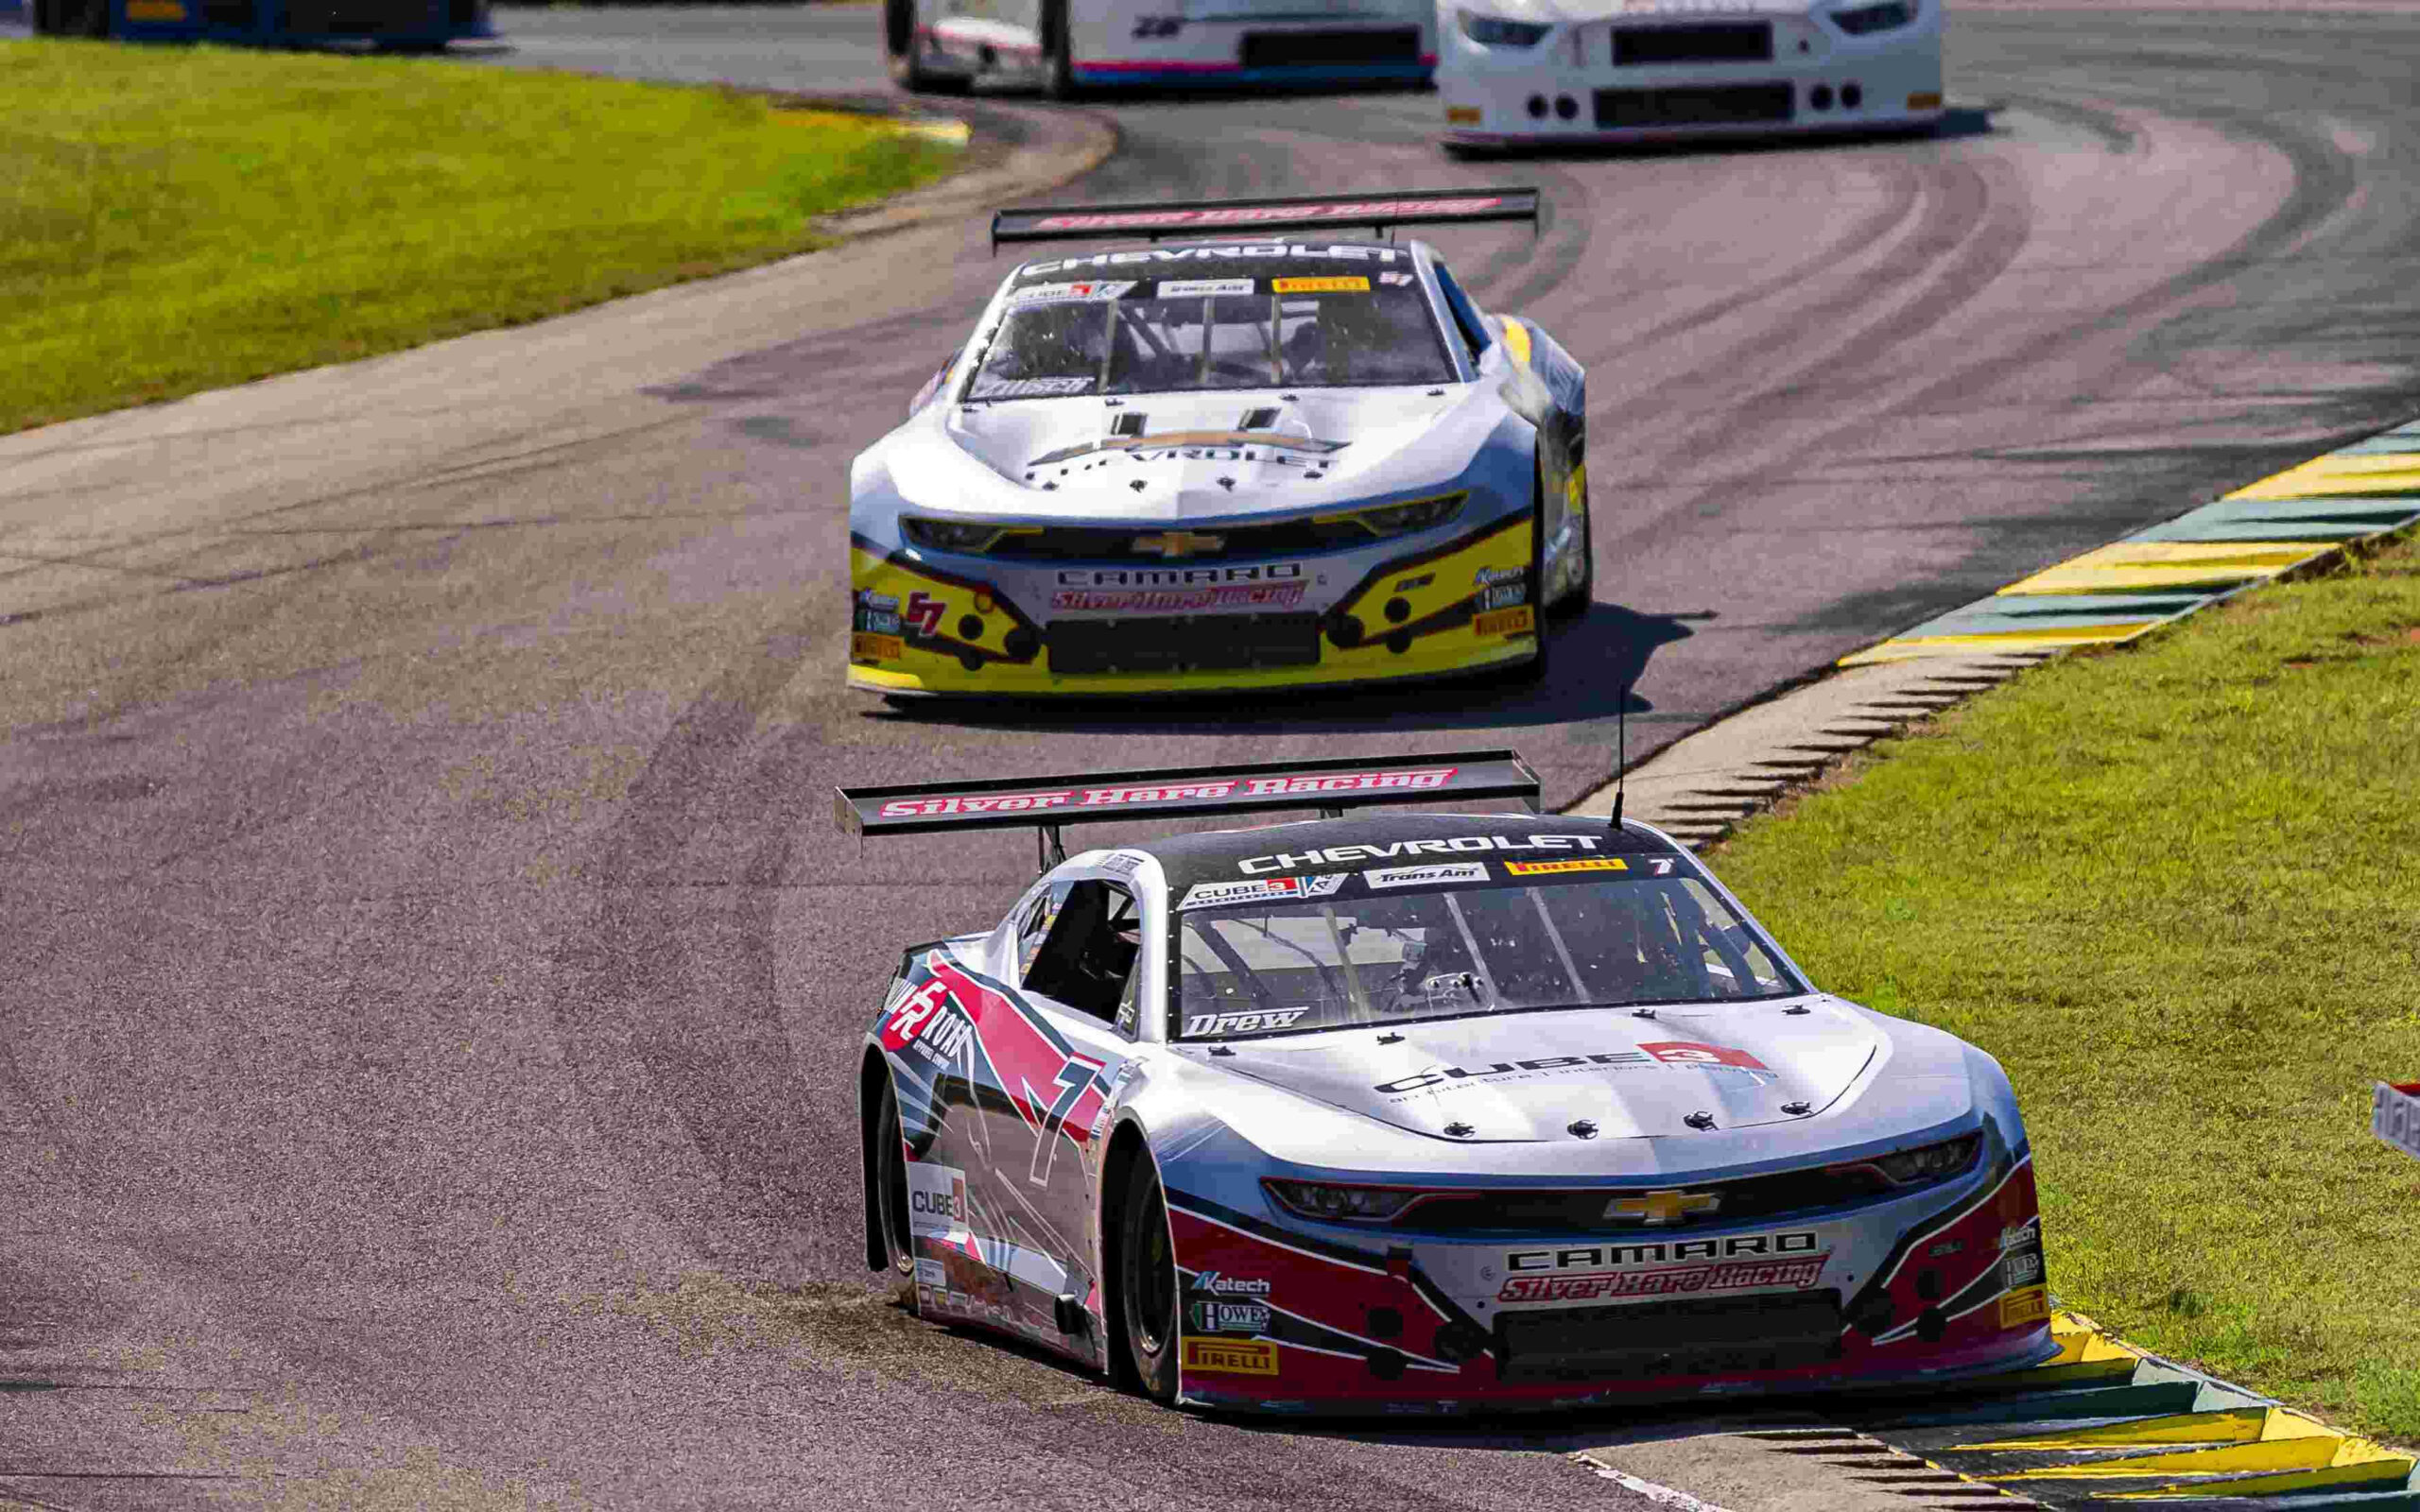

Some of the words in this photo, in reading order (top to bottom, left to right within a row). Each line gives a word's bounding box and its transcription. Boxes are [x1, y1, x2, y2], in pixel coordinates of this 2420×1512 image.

[1022, 245, 1409, 276] CHEVROLET
[1057, 564, 1302, 586] CAMARO
[881, 791, 1074, 818] Silver
[1079, 780, 1238, 805] Hare
[1243, 767, 1459, 798] Racing
[1238, 835, 1602, 874] CHEVROLET
[1517, 859, 1616, 872] PIRELLI
[1648, 858, 1675, 875] 7
[1380, 871, 1437, 883] Trans
[1440, 868, 1478, 879] Am
[1194, 882, 1287, 901] CUBE3
[1181, 1005, 1310, 1038] Drew
[1374, 1047, 1716, 1094] CUBE3
[1029, 1051, 1108, 1188] 7
[911, 1191, 962, 1220] CUBE3
[1507, 1231, 1817, 1272] CAMARO
[1193, 1271, 1270, 1297] Katech
[1497, 1273, 1613, 1302] Silver
[1610, 1266, 1714, 1297] Hare
[1707, 1254, 1831, 1289] Racing
[1187, 1342, 1271, 1369] PIRELLI
